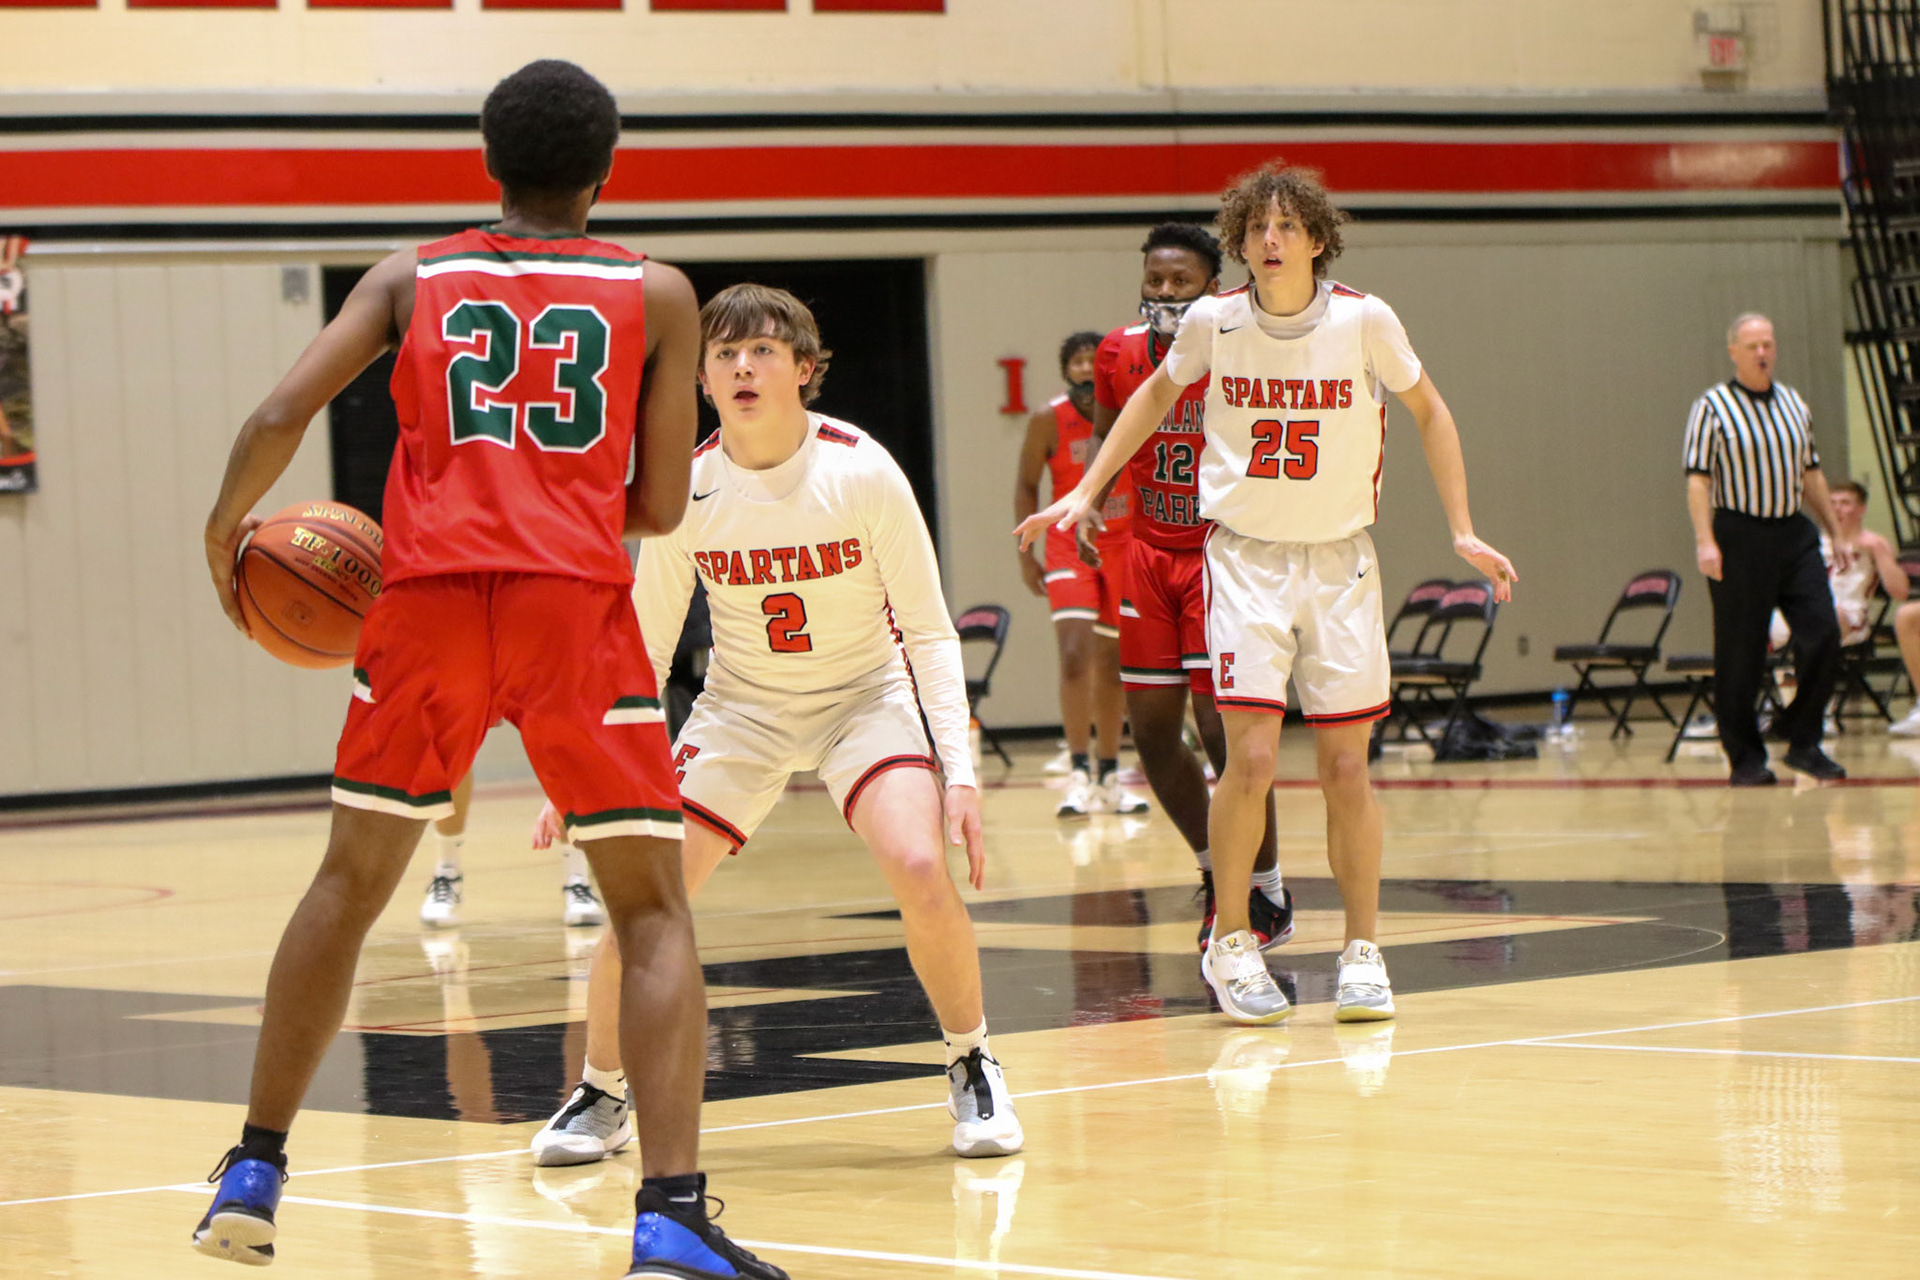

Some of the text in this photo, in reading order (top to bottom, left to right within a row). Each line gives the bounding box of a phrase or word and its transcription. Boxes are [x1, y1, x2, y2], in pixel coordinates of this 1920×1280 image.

[442, 298, 611, 454] 23
[1221, 376, 1353, 410] SPARTANS
[1153, 441, 1195, 486] 12
[1245, 419, 1320, 481] 25
[693, 537, 863, 586] SPARTANS
[761, 592, 813, 653] 2
[1219, 652, 1235, 689] E
[673, 743, 701, 785] E
